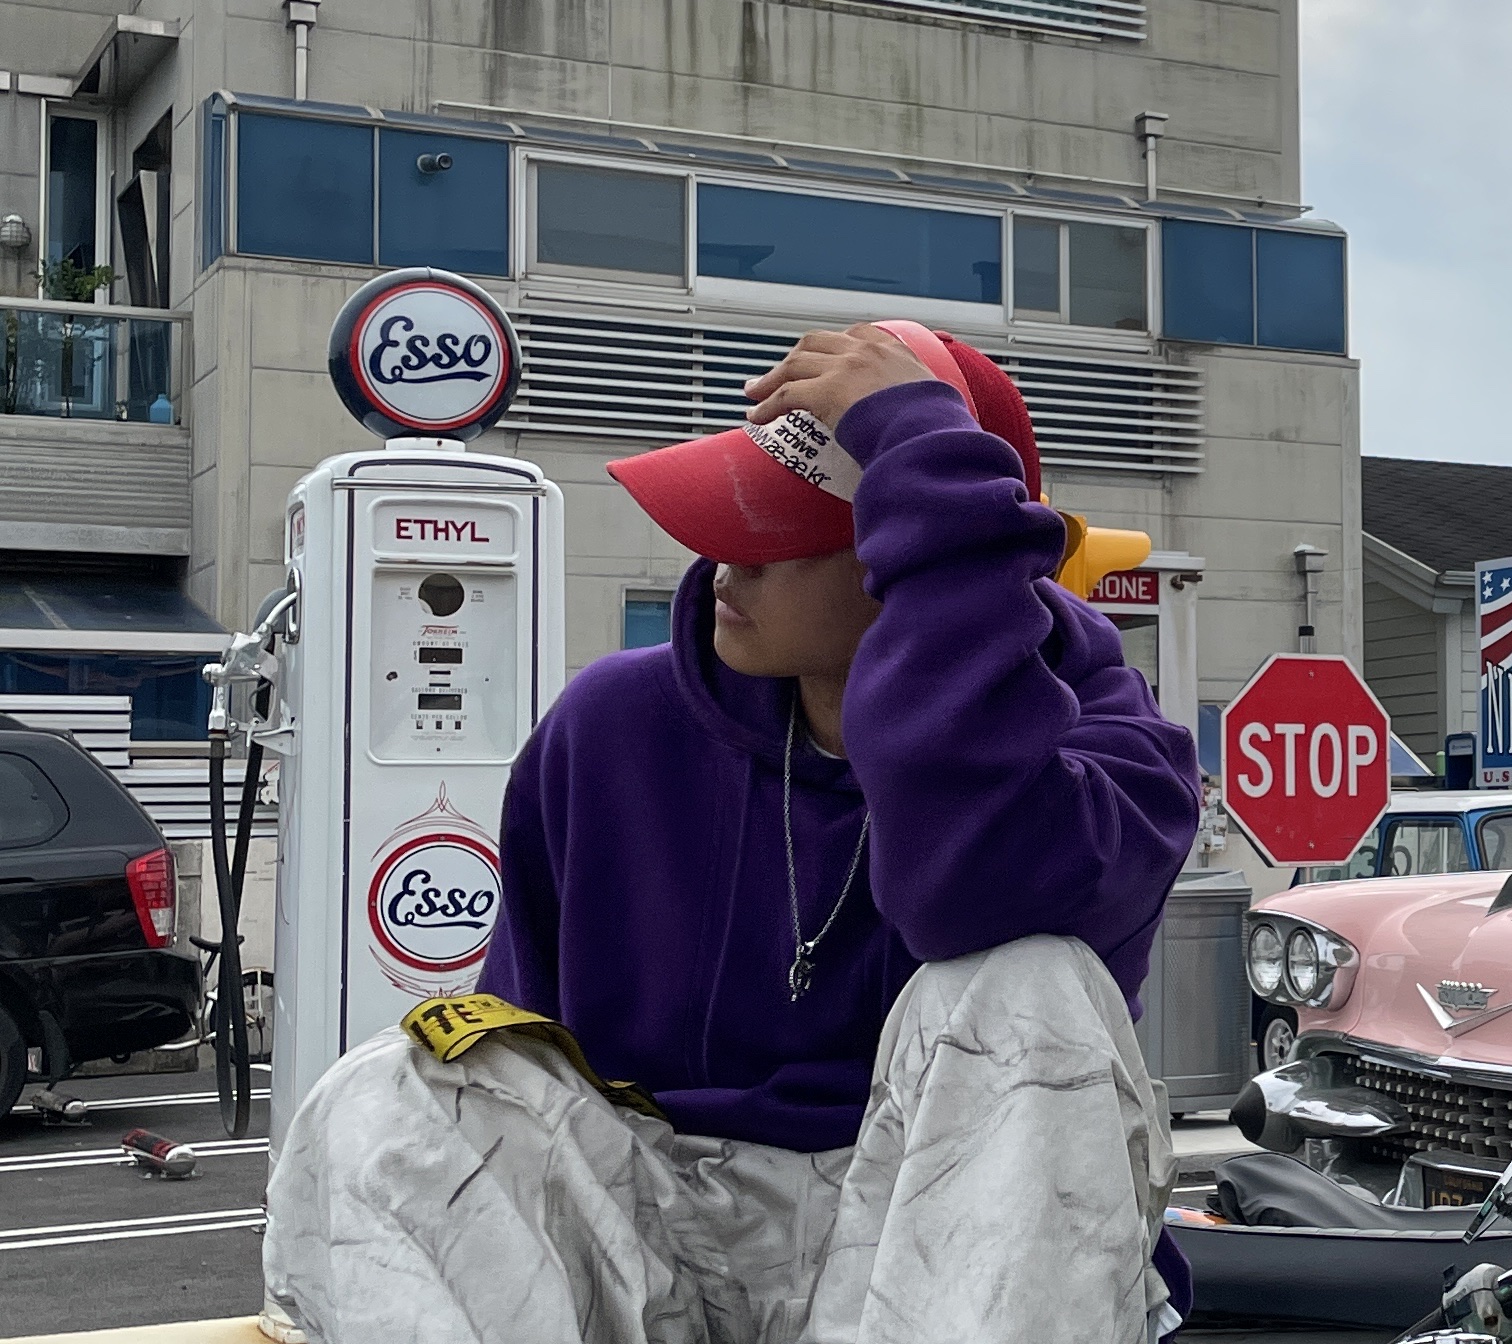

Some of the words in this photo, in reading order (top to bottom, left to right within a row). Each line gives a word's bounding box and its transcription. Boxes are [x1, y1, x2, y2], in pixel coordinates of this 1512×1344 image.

[369, 315, 492, 385] Esso
[774, 424, 819, 460] archive
[395, 518, 490, 543] ETHYL
[1238, 722, 1379, 799] STOP
[388, 869, 495, 929] Esso
